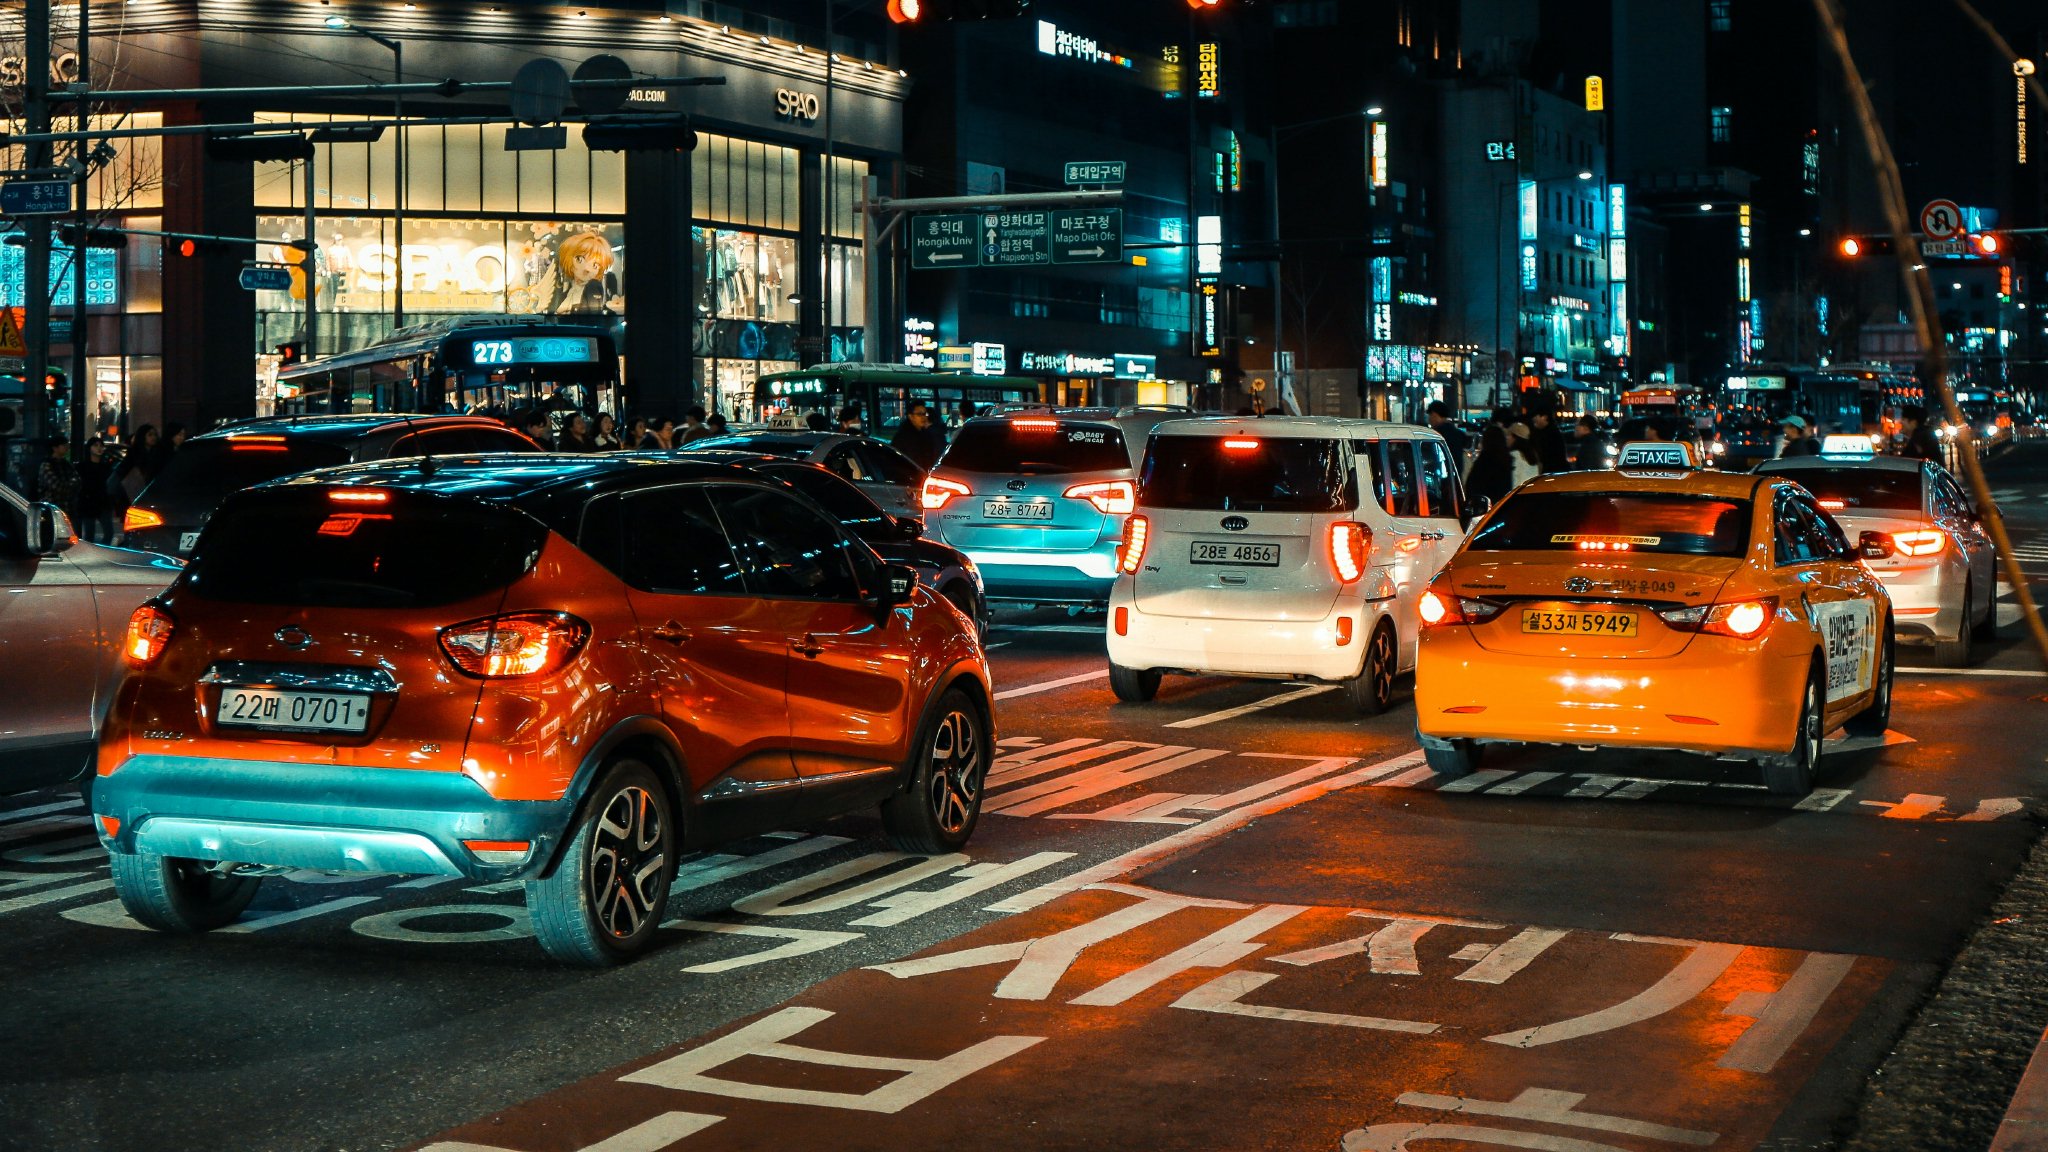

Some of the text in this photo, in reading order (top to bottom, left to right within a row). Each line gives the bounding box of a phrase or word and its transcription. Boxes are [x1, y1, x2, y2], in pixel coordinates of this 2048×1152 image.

[776, 88, 819, 120] SPAO
[1068, 165, 1123, 181] 홍대입구역
[32, 184, 66, 200] 홍익로
[25, 202, 67, 211] Hongik-ro
[986, 216, 997, 226] 70
[1000, 213, 1045, 227] 양화대교
[1061, 216, 1110, 231] 마포구청
[928, 220, 964, 235] 홍익대
[917, 237, 973, 249] Hongik Univ
[1055, 232, 1116, 244] Mapo Dist Ofc
[988, 246, 994, 254] 6
[1000, 239, 1033, 252] 합정역
[1000, 251, 1048, 263] Hapjeong Stn
[358, 244, 517, 292] SPAO
[474, 341, 513, 363] 273
[773, 419, 792, 427] TAXI
[1832, 442, 1864, 452] TAXI
[1640, 451, 1668, 463] TAXI
[990, 504, 1047, 516] 28누 8774
[1199, 545, 1271, 561] 28로 4856
[1581, 614, 1631, 633] 5949
[232, 694, 351, 725] 22머 0701
